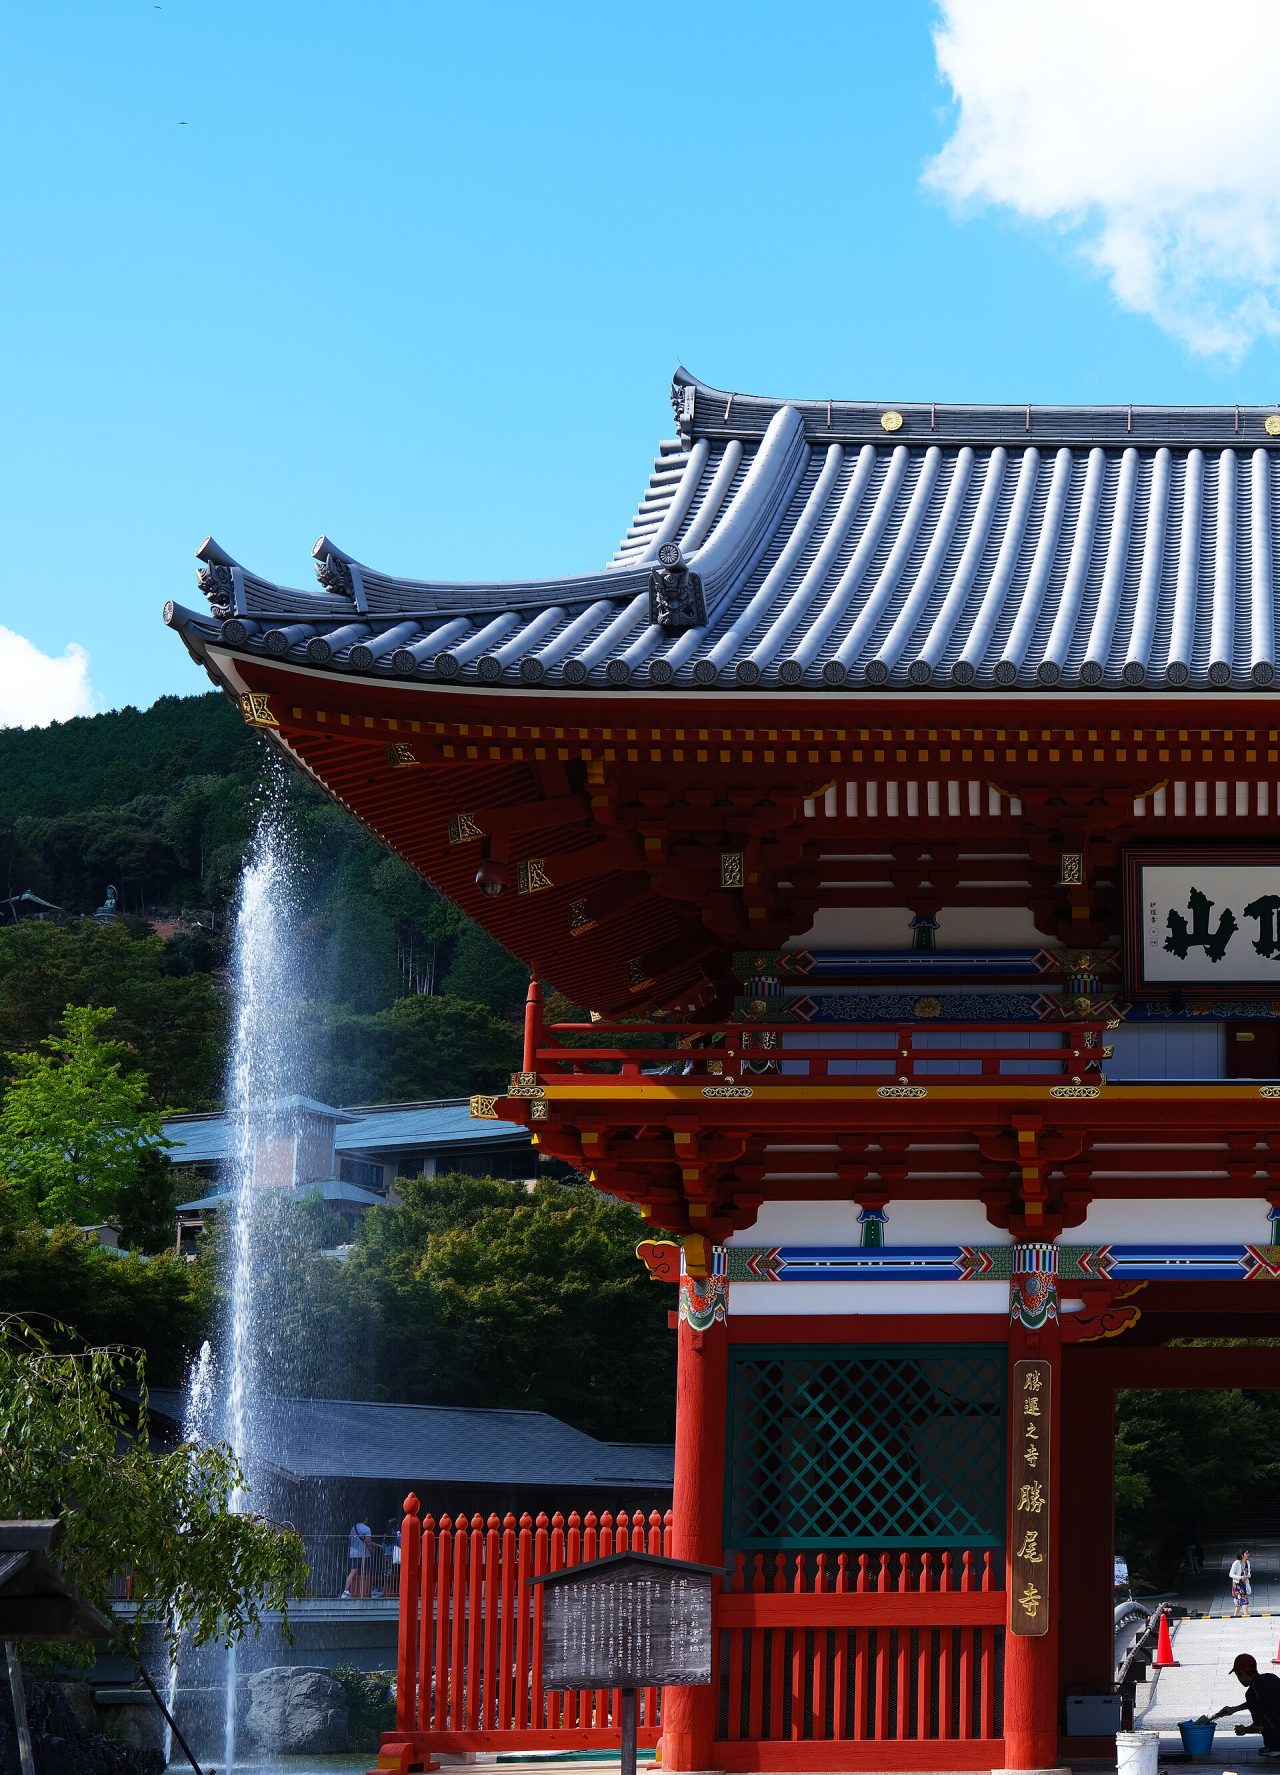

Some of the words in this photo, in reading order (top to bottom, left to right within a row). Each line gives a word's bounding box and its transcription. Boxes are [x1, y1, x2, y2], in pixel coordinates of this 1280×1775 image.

[1023, 1370, 1043, 1468] 勝運之寺
[1017, 1480, 1046, 1618] 勝尾寺
